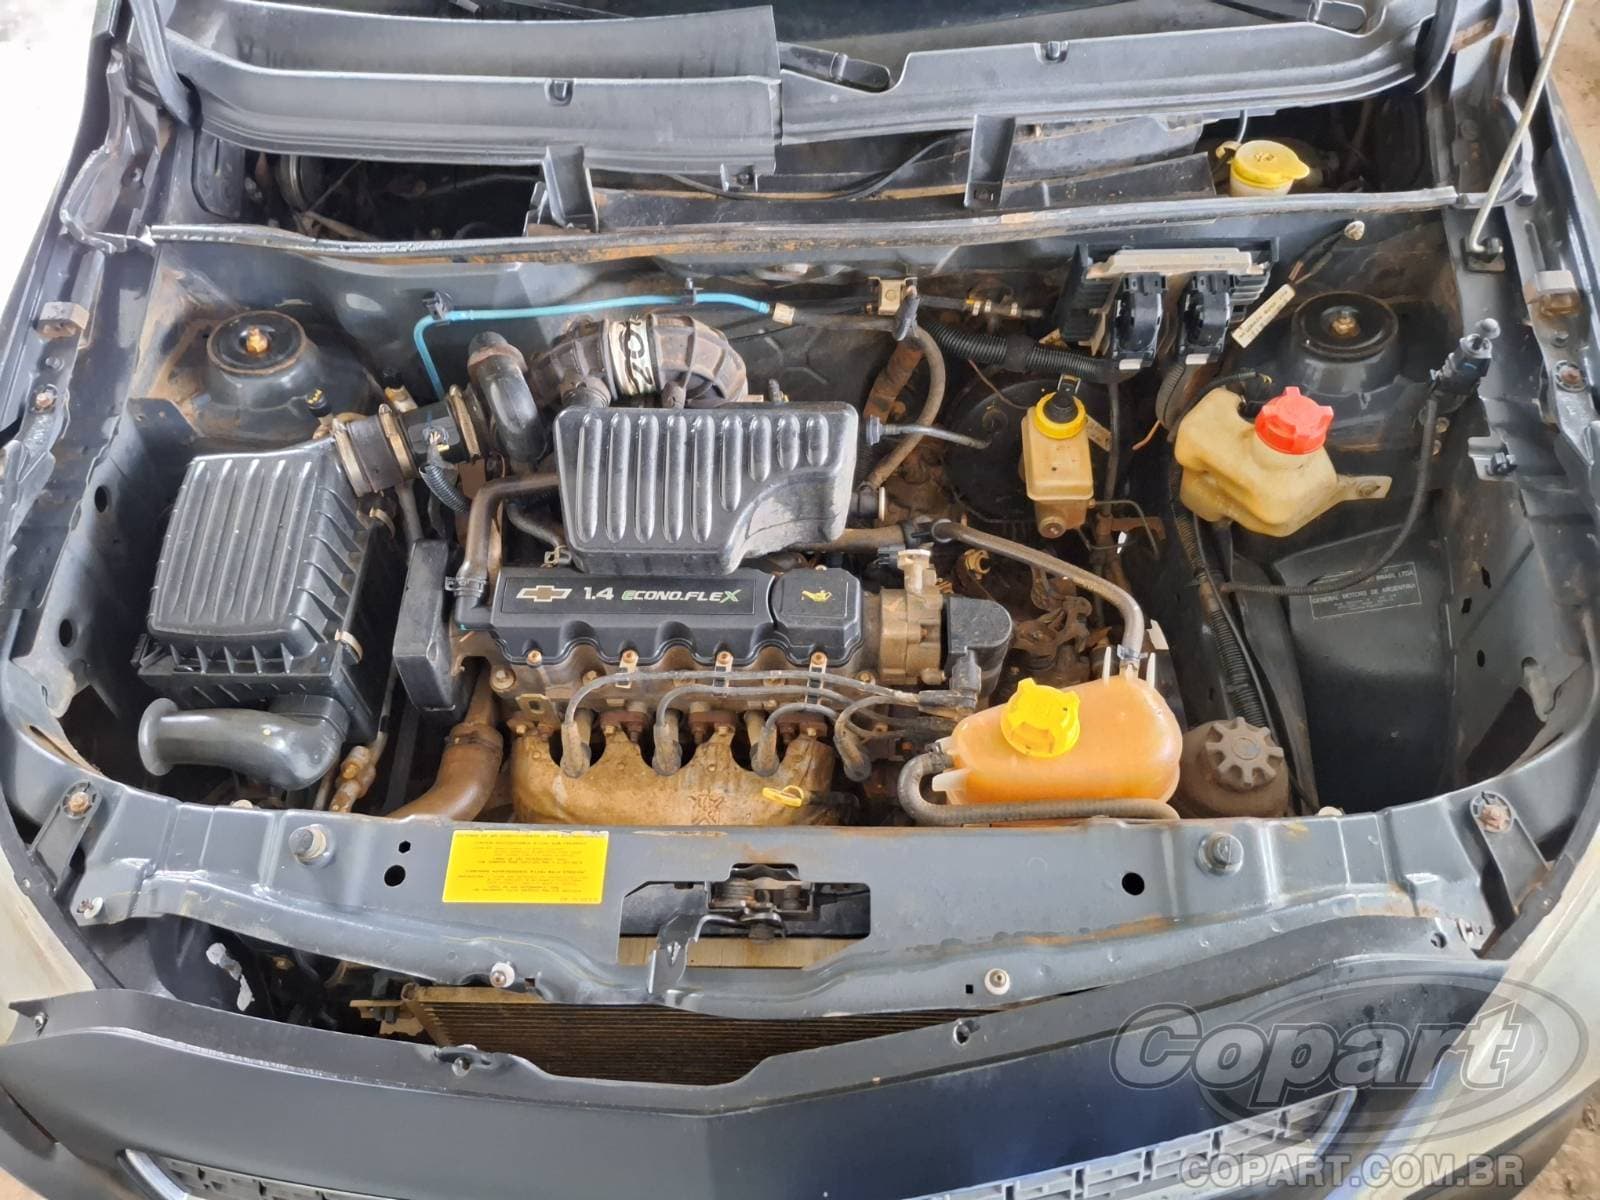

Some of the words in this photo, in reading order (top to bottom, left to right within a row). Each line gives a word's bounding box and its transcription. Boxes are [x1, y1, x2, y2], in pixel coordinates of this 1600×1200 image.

[583, 586, 614, 601] 1.4
[1311, 595, 1340, 604] GENERAL
[1342, 590, 1368, 600] MOTORS
